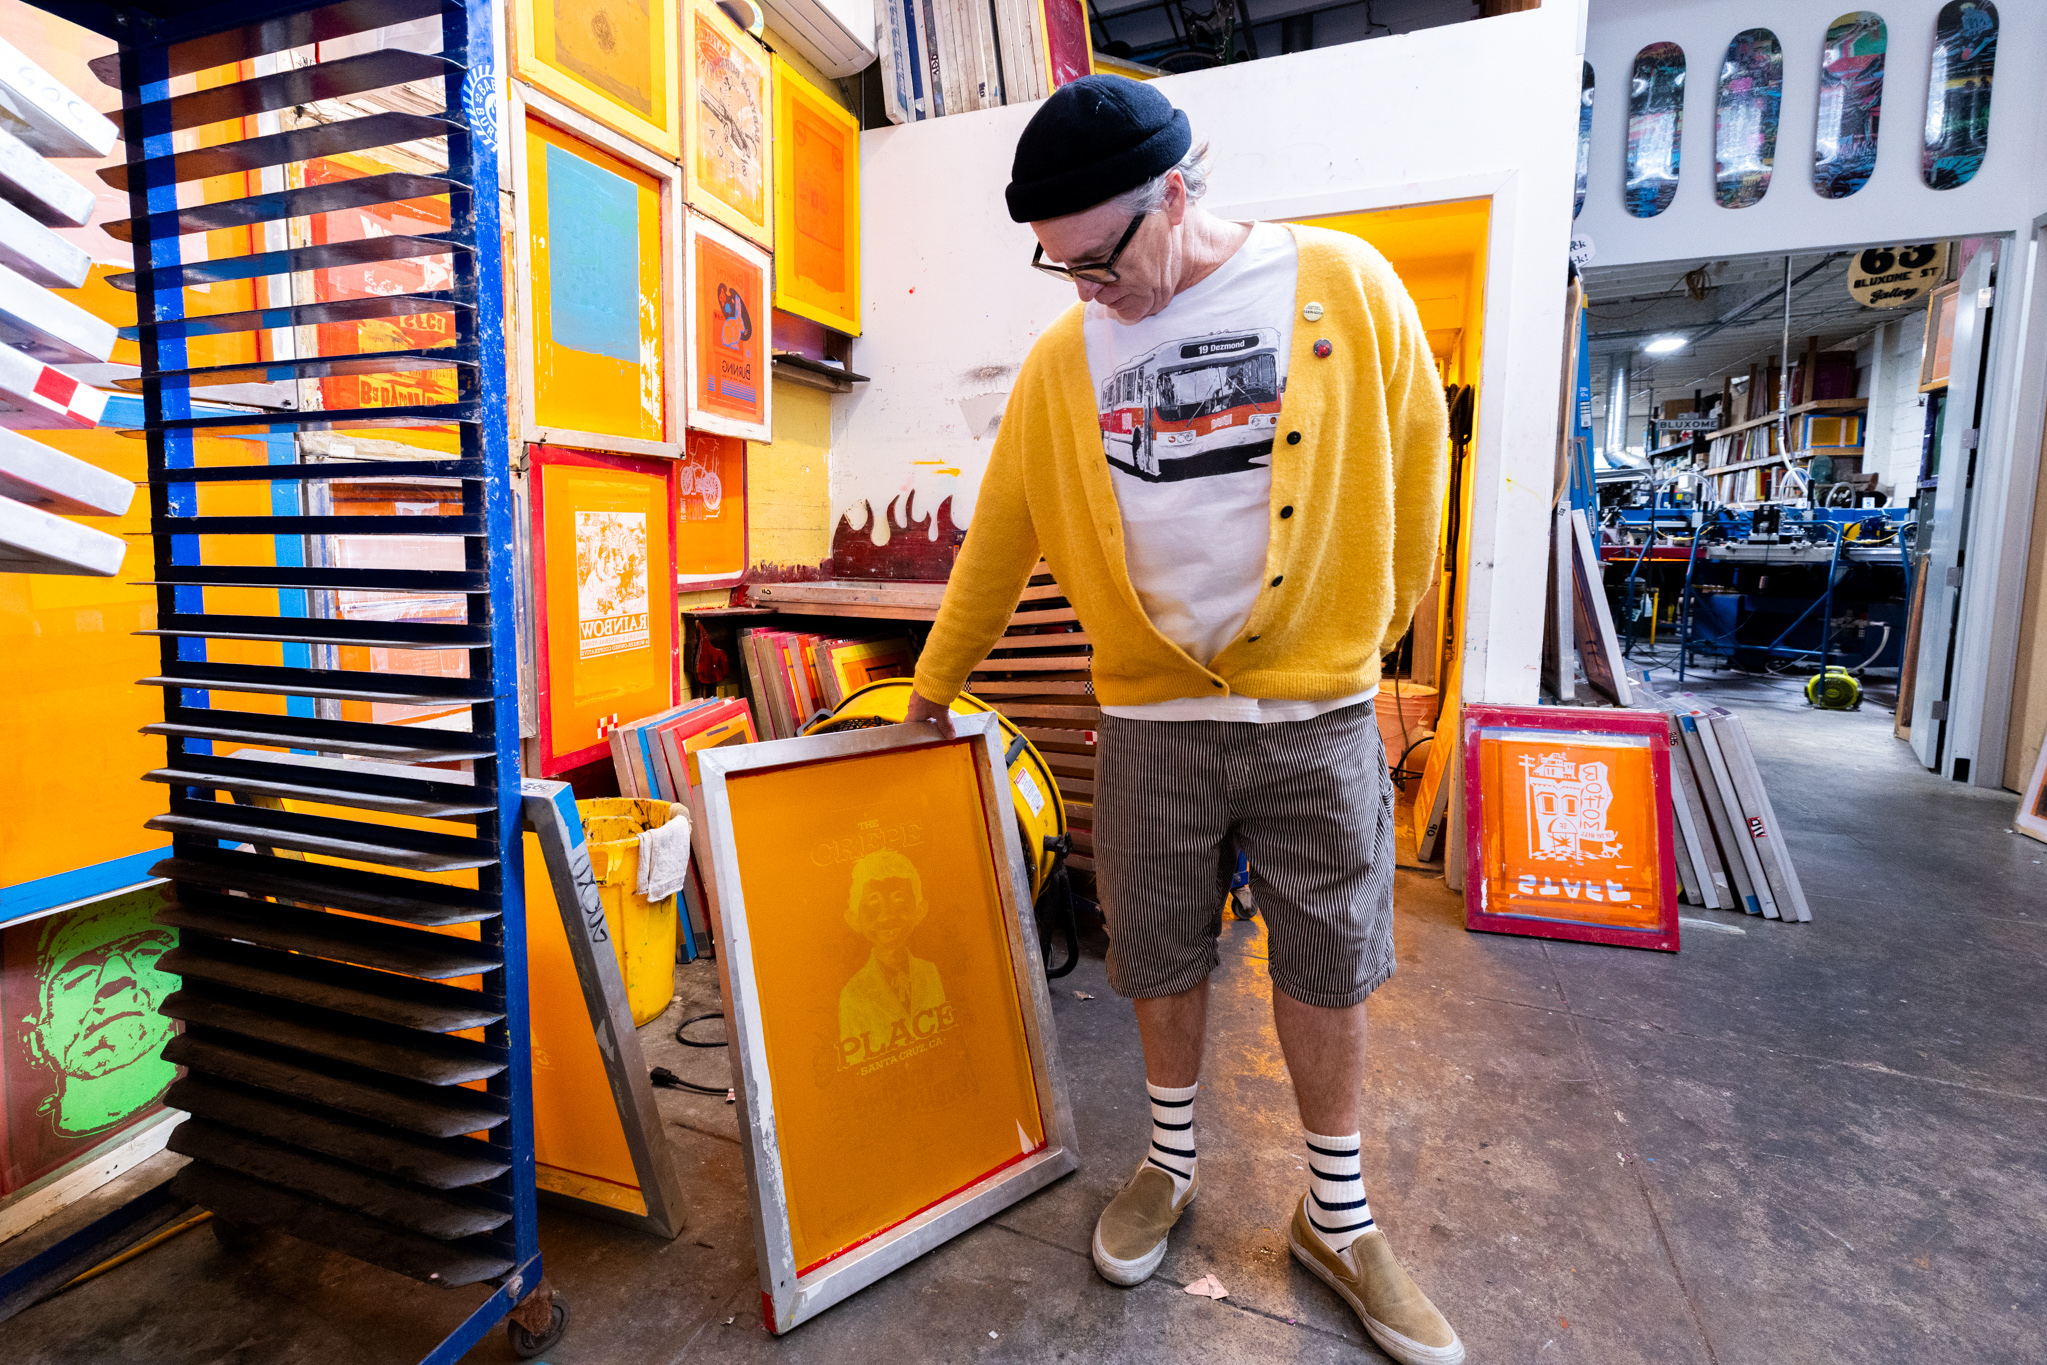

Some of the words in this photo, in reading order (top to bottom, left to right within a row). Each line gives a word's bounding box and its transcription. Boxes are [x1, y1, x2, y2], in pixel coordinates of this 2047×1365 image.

[474, 93, 484, 104] SF
[475, 107, 498, 142] BUR
[1860, 244, 1936, 275] 63
[1853, 271, 1913, 289] BLUXOME
[1920, 267, 1939, 278] ST
[1869, 287, 1919, 304] Gallery
[1198, 345, 1209, 354] 19
[1210, 340, 1246, 353] Dezmond
[1660, 420, 1717, 429] BLUXOME
[857, 819, 879, 830] THE
[811, 824, 924, 867] CREPE
[834, 1001, 958, 1072] PLACE
[860, 1055, 898, 1076] SANTA
